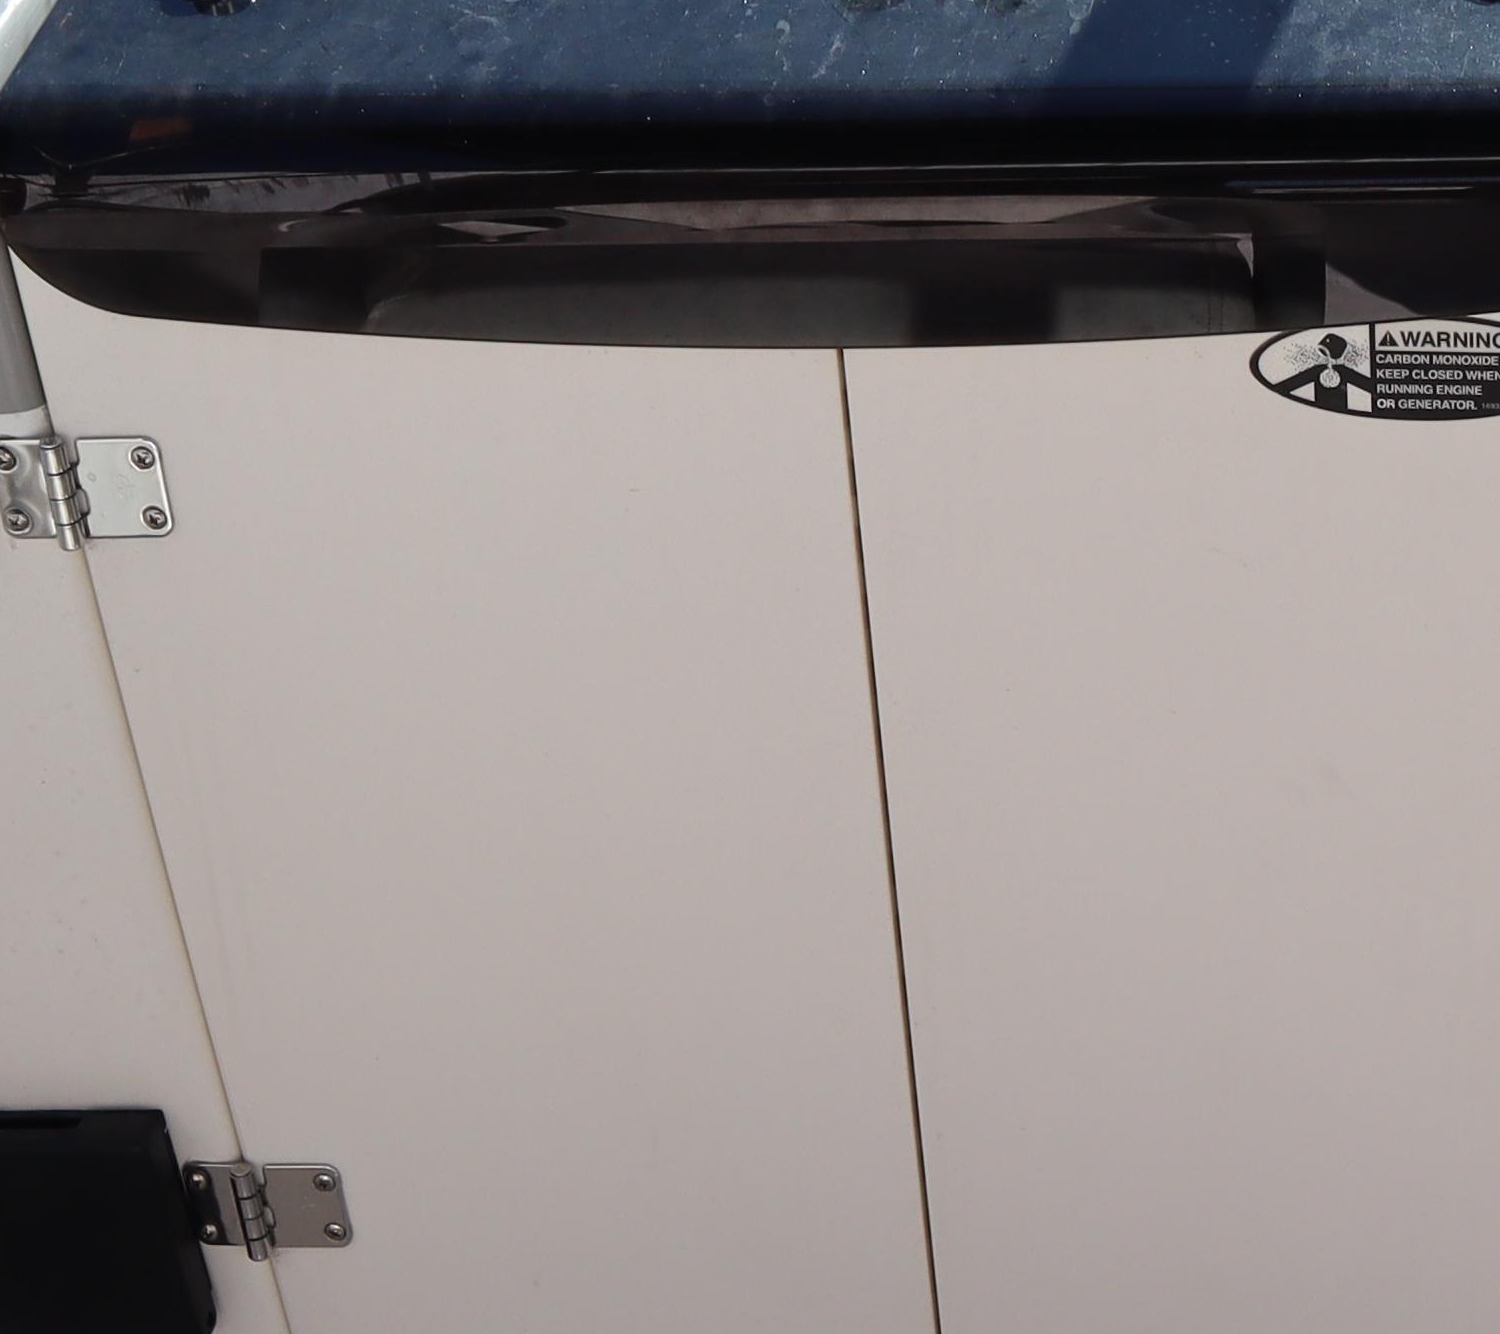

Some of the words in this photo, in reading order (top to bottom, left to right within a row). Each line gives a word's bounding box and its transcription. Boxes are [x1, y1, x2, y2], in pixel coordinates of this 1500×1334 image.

[1375, 354, 1430, 365] CARBON
[1432, 354, 1499, 366] MONOXIDE
[1376, 369, 1409, 380] KEEP
[1412, 369, 1464, 381] CLOSED
[1376, 384, 1434, 395] RUNNING
[1436, 385, 1483, 396] ENGINE
[1376, 398, 1396, 409] OR
[1398, 399, 1478, 411] GENERATOR.
